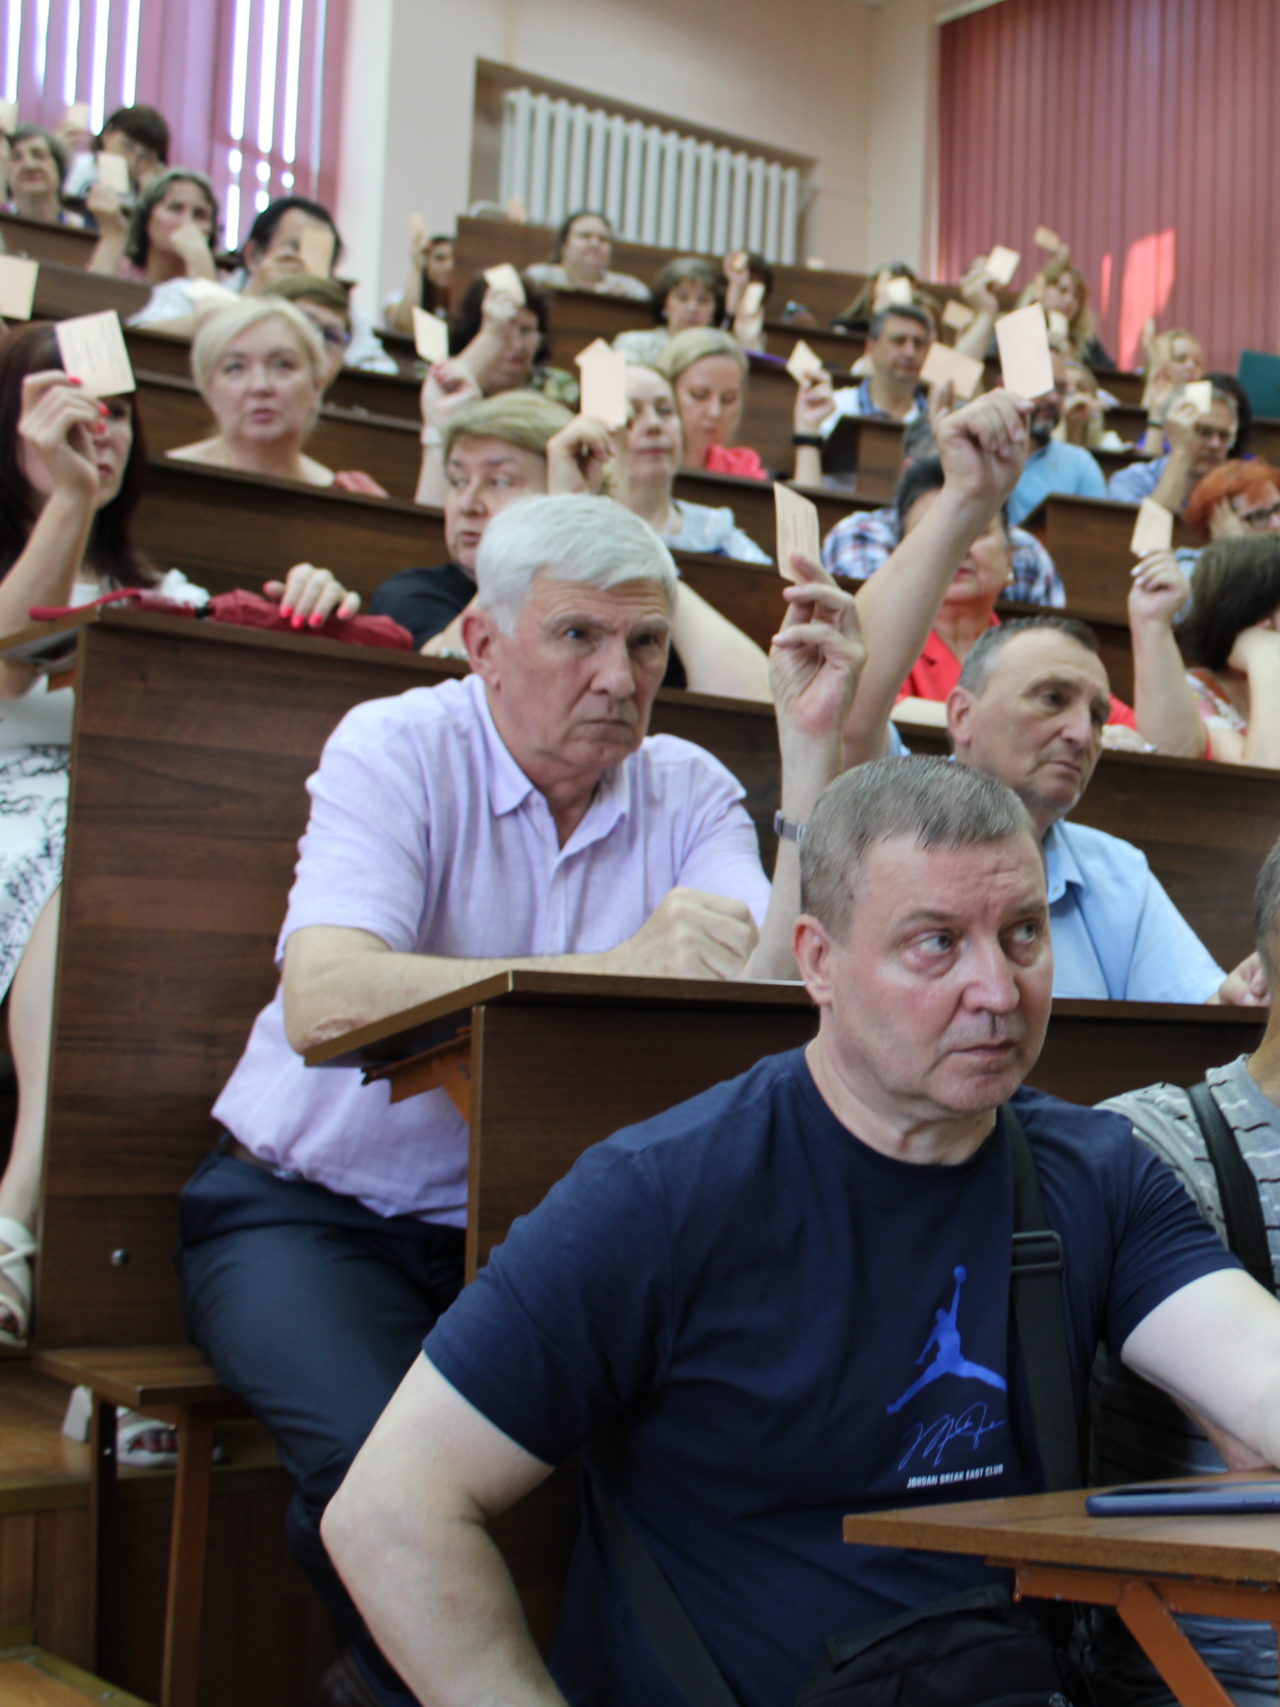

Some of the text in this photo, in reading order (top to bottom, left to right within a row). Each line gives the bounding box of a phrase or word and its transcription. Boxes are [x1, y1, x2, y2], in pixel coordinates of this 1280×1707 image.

[907, 1474, 938, 1489] JORDAN
[939, 1470, 964, 1485] BREAK
[985, 1463, 1004, 1477] CLUB
